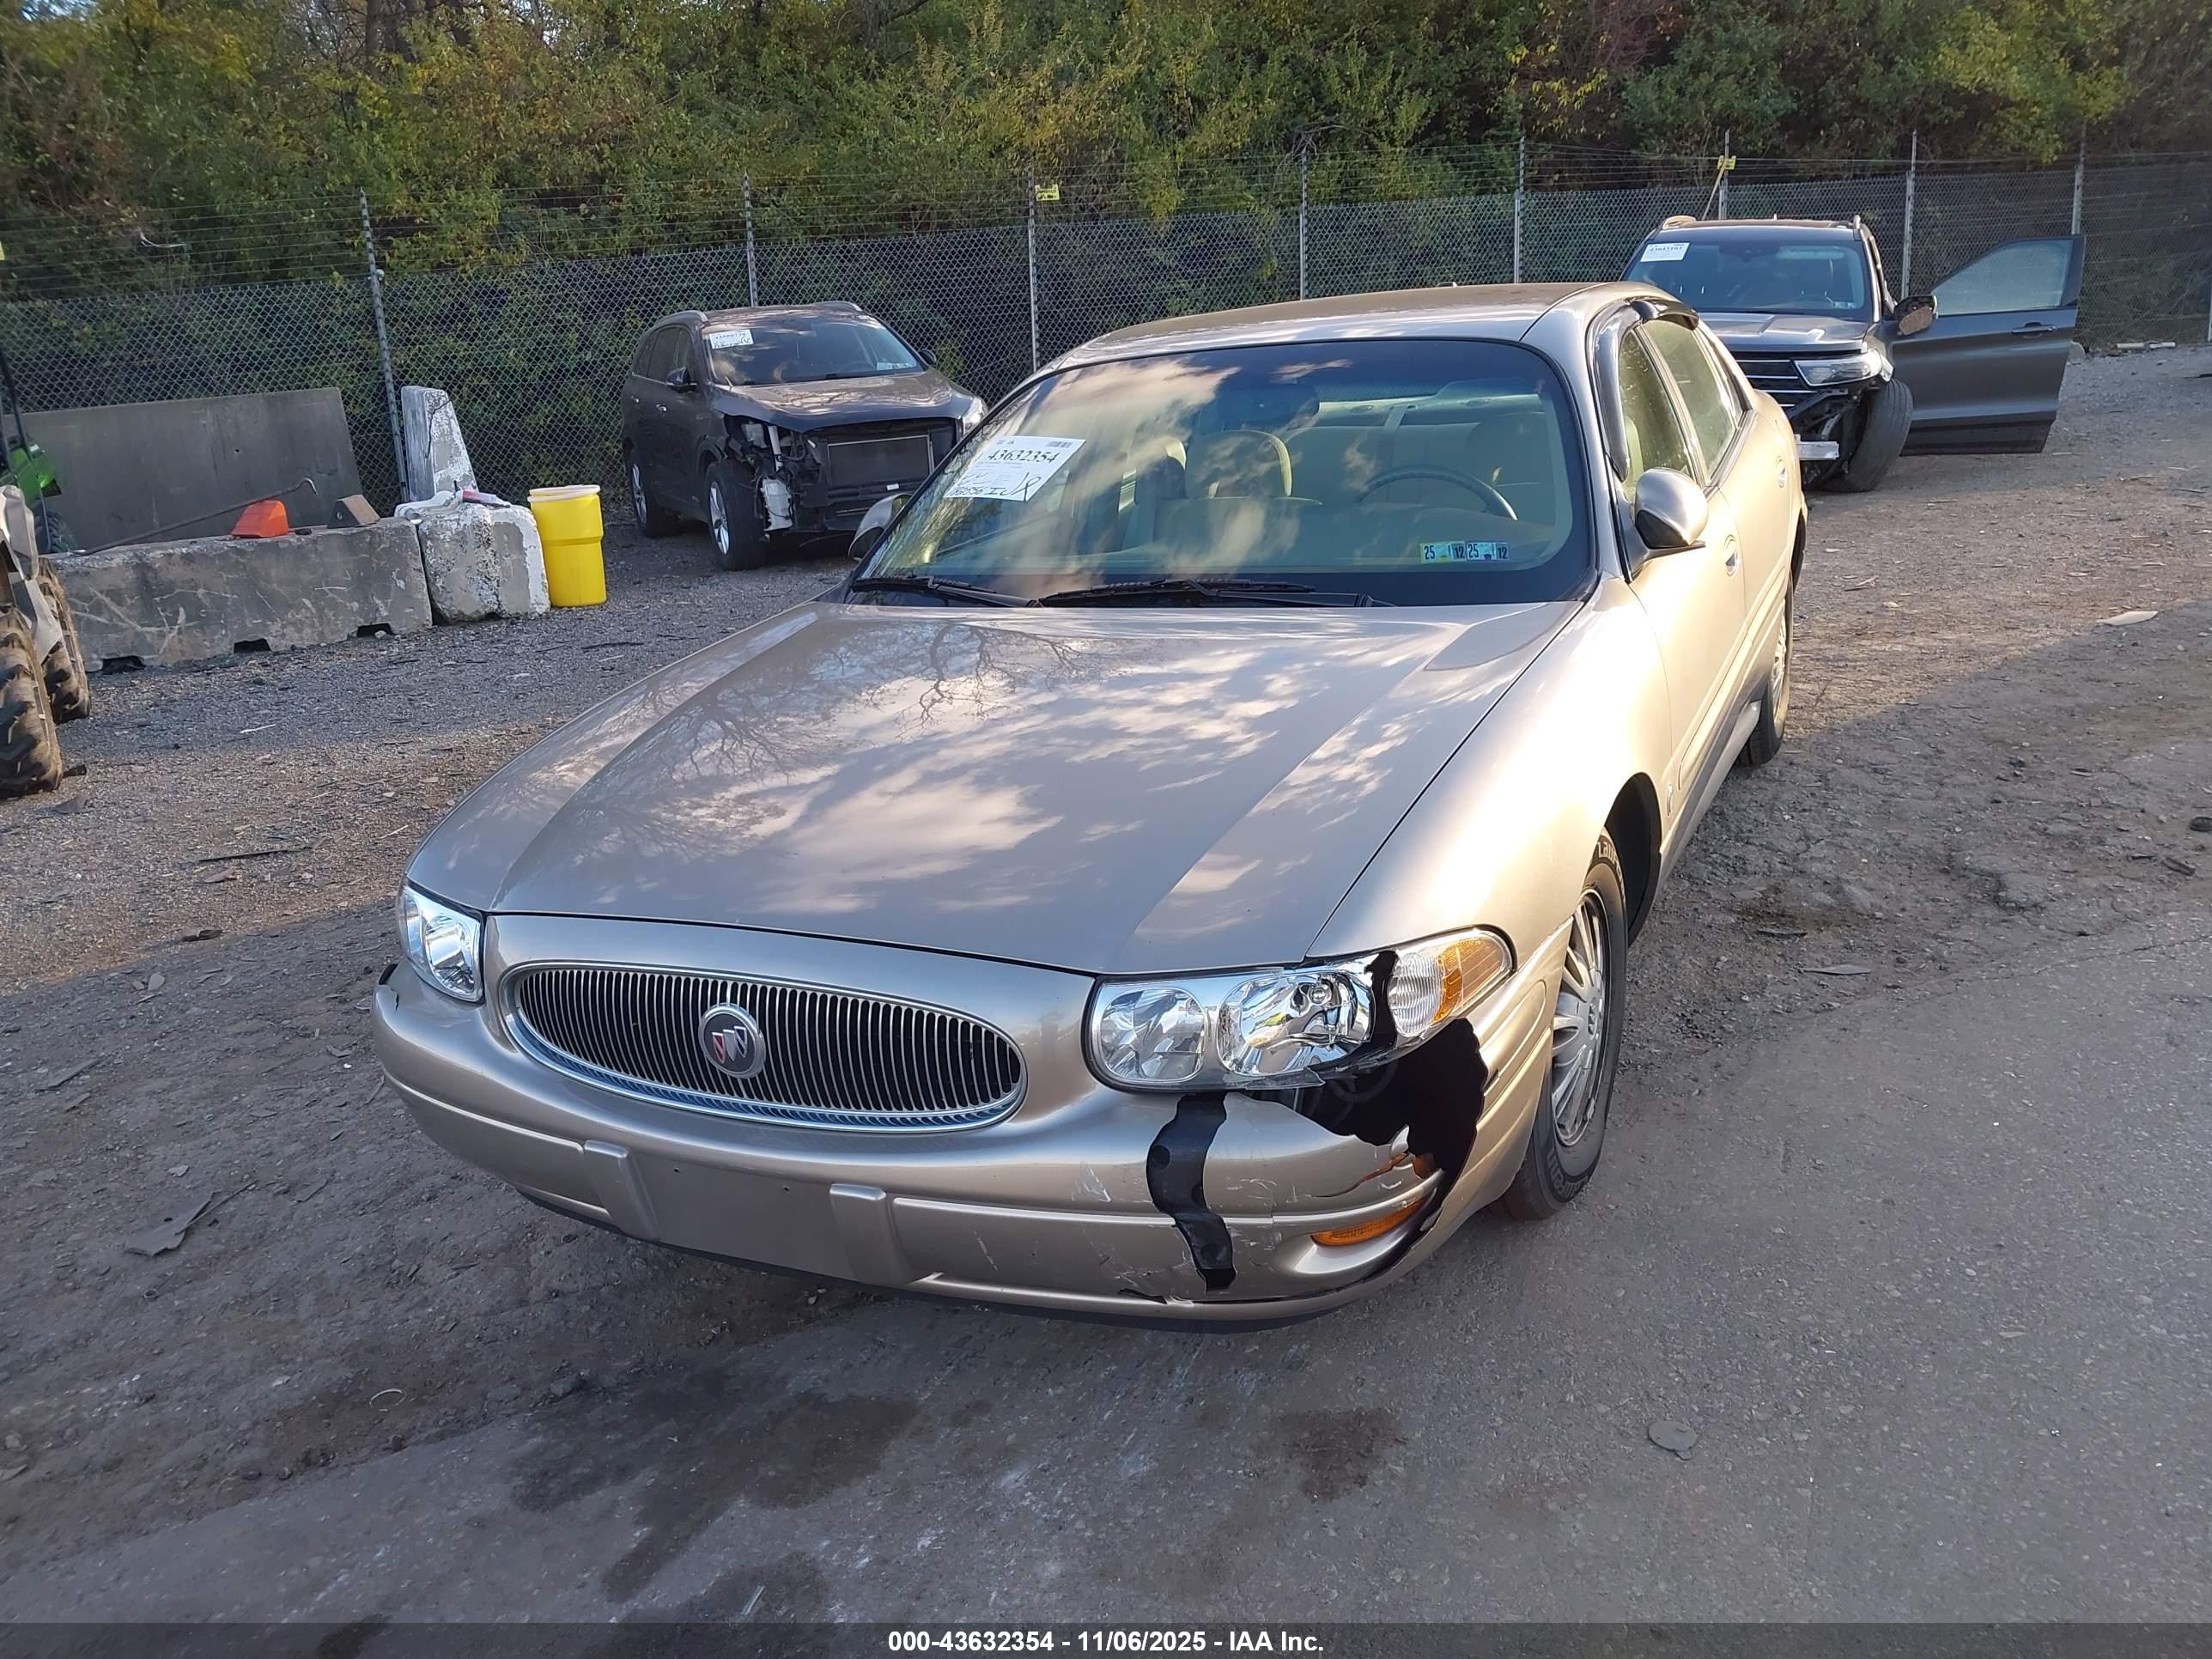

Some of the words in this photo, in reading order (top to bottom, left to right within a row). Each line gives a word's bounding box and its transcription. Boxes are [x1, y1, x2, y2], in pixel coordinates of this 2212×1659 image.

[988, 449, 1060, 464] 43632354
[1424, 545, 1436, 560] 25
[1455, 545, 1466, 559] 12
[1468, 544, 1479, 558] 25
[1498, 546, 1508, 559] 12
